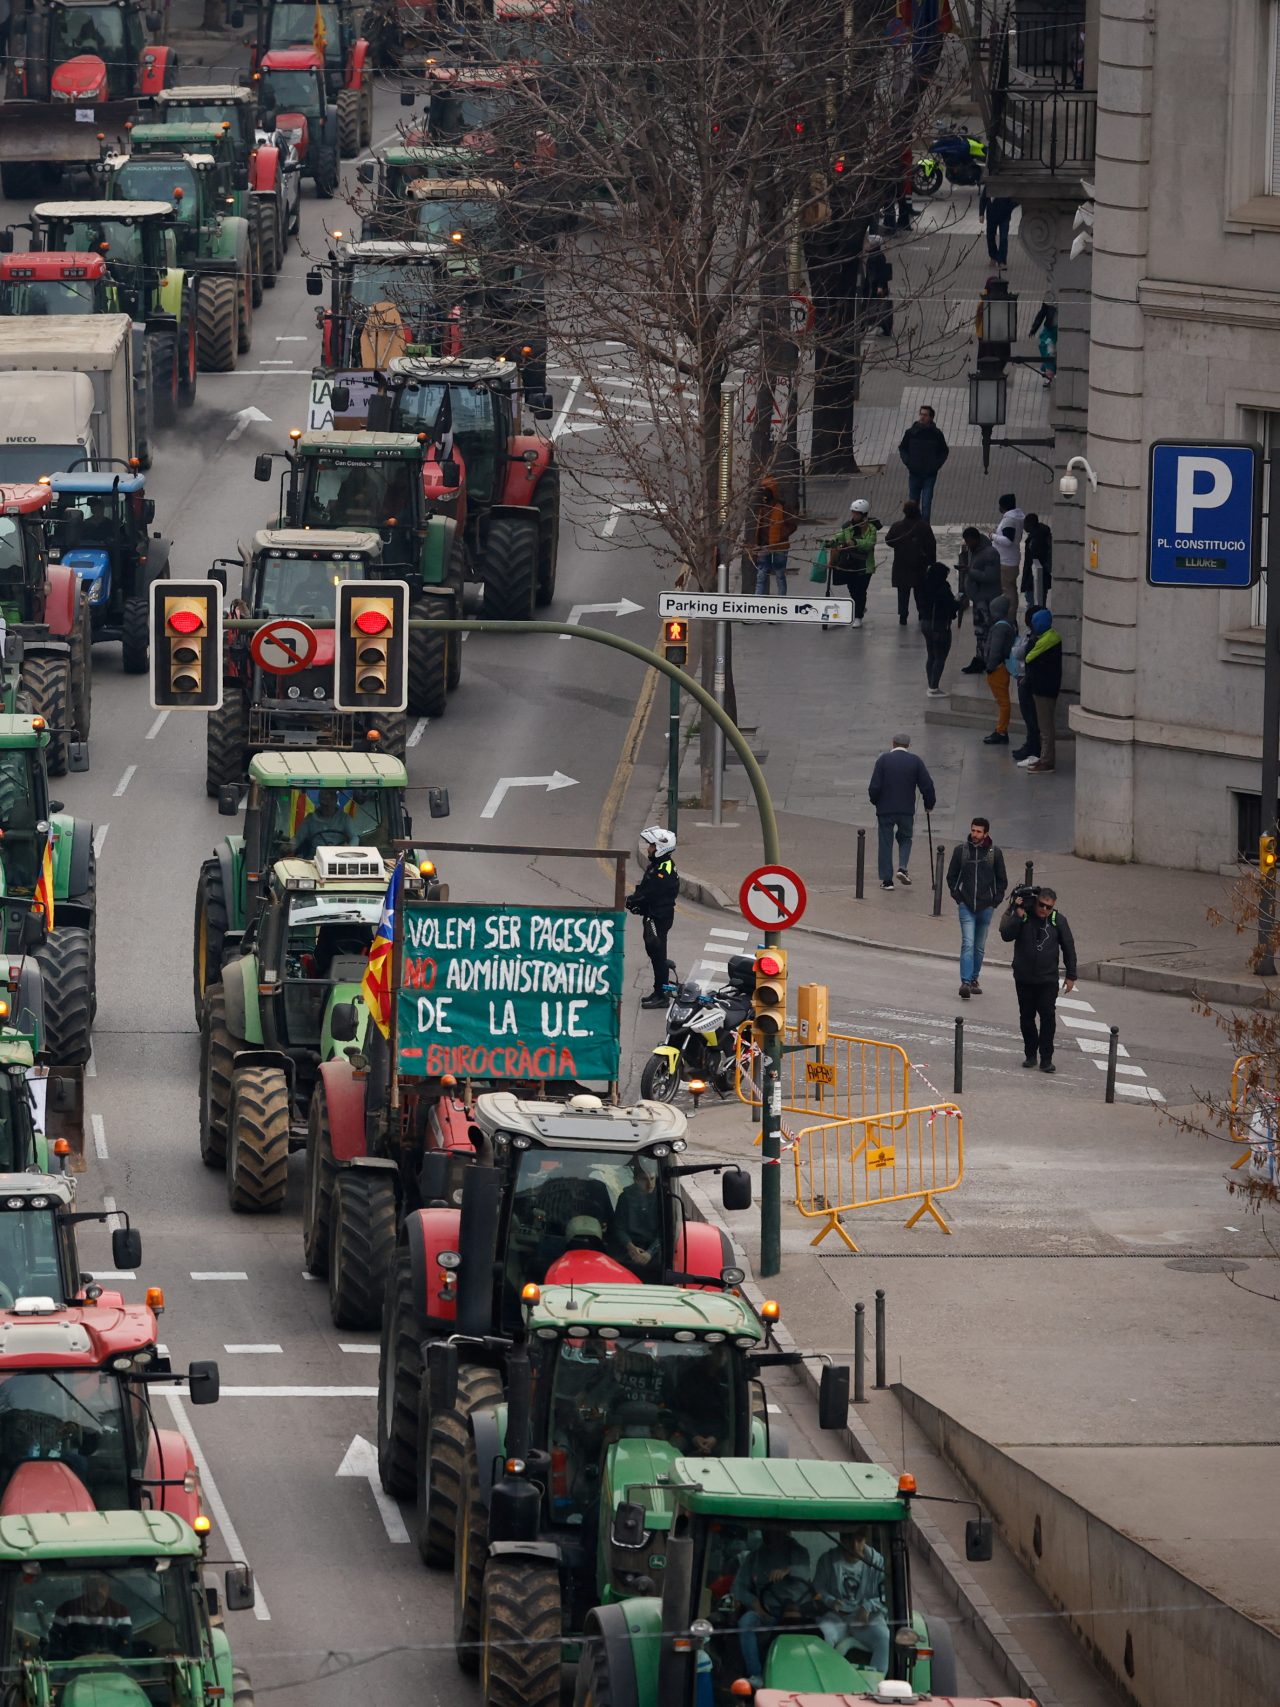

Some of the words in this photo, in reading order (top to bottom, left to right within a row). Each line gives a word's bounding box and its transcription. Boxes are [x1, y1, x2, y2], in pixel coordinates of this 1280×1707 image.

[313, 381, 333, 404] LA
[311, 410, 335, 430] LA
[1175, 455, 1233, 534] P
[1157, 538, 1173, 549] PL.
[1175, 539, 1246, 551] CONSTITUCIÓ
[666, 598, 718, 614] Parking
[722, 600, 788, 615] Eiximenis
[408, 916, 476, 950] VOLEM
[484, 915, 521, 950] SER
[530, 915, 614, 955] PAGESOS
[404, 956, 438, 990] NO
[417, 996, 453, 1033] DE
[489, 1000, 519, 1035] LA
[541, 1000, 594, 1037] U.E.
